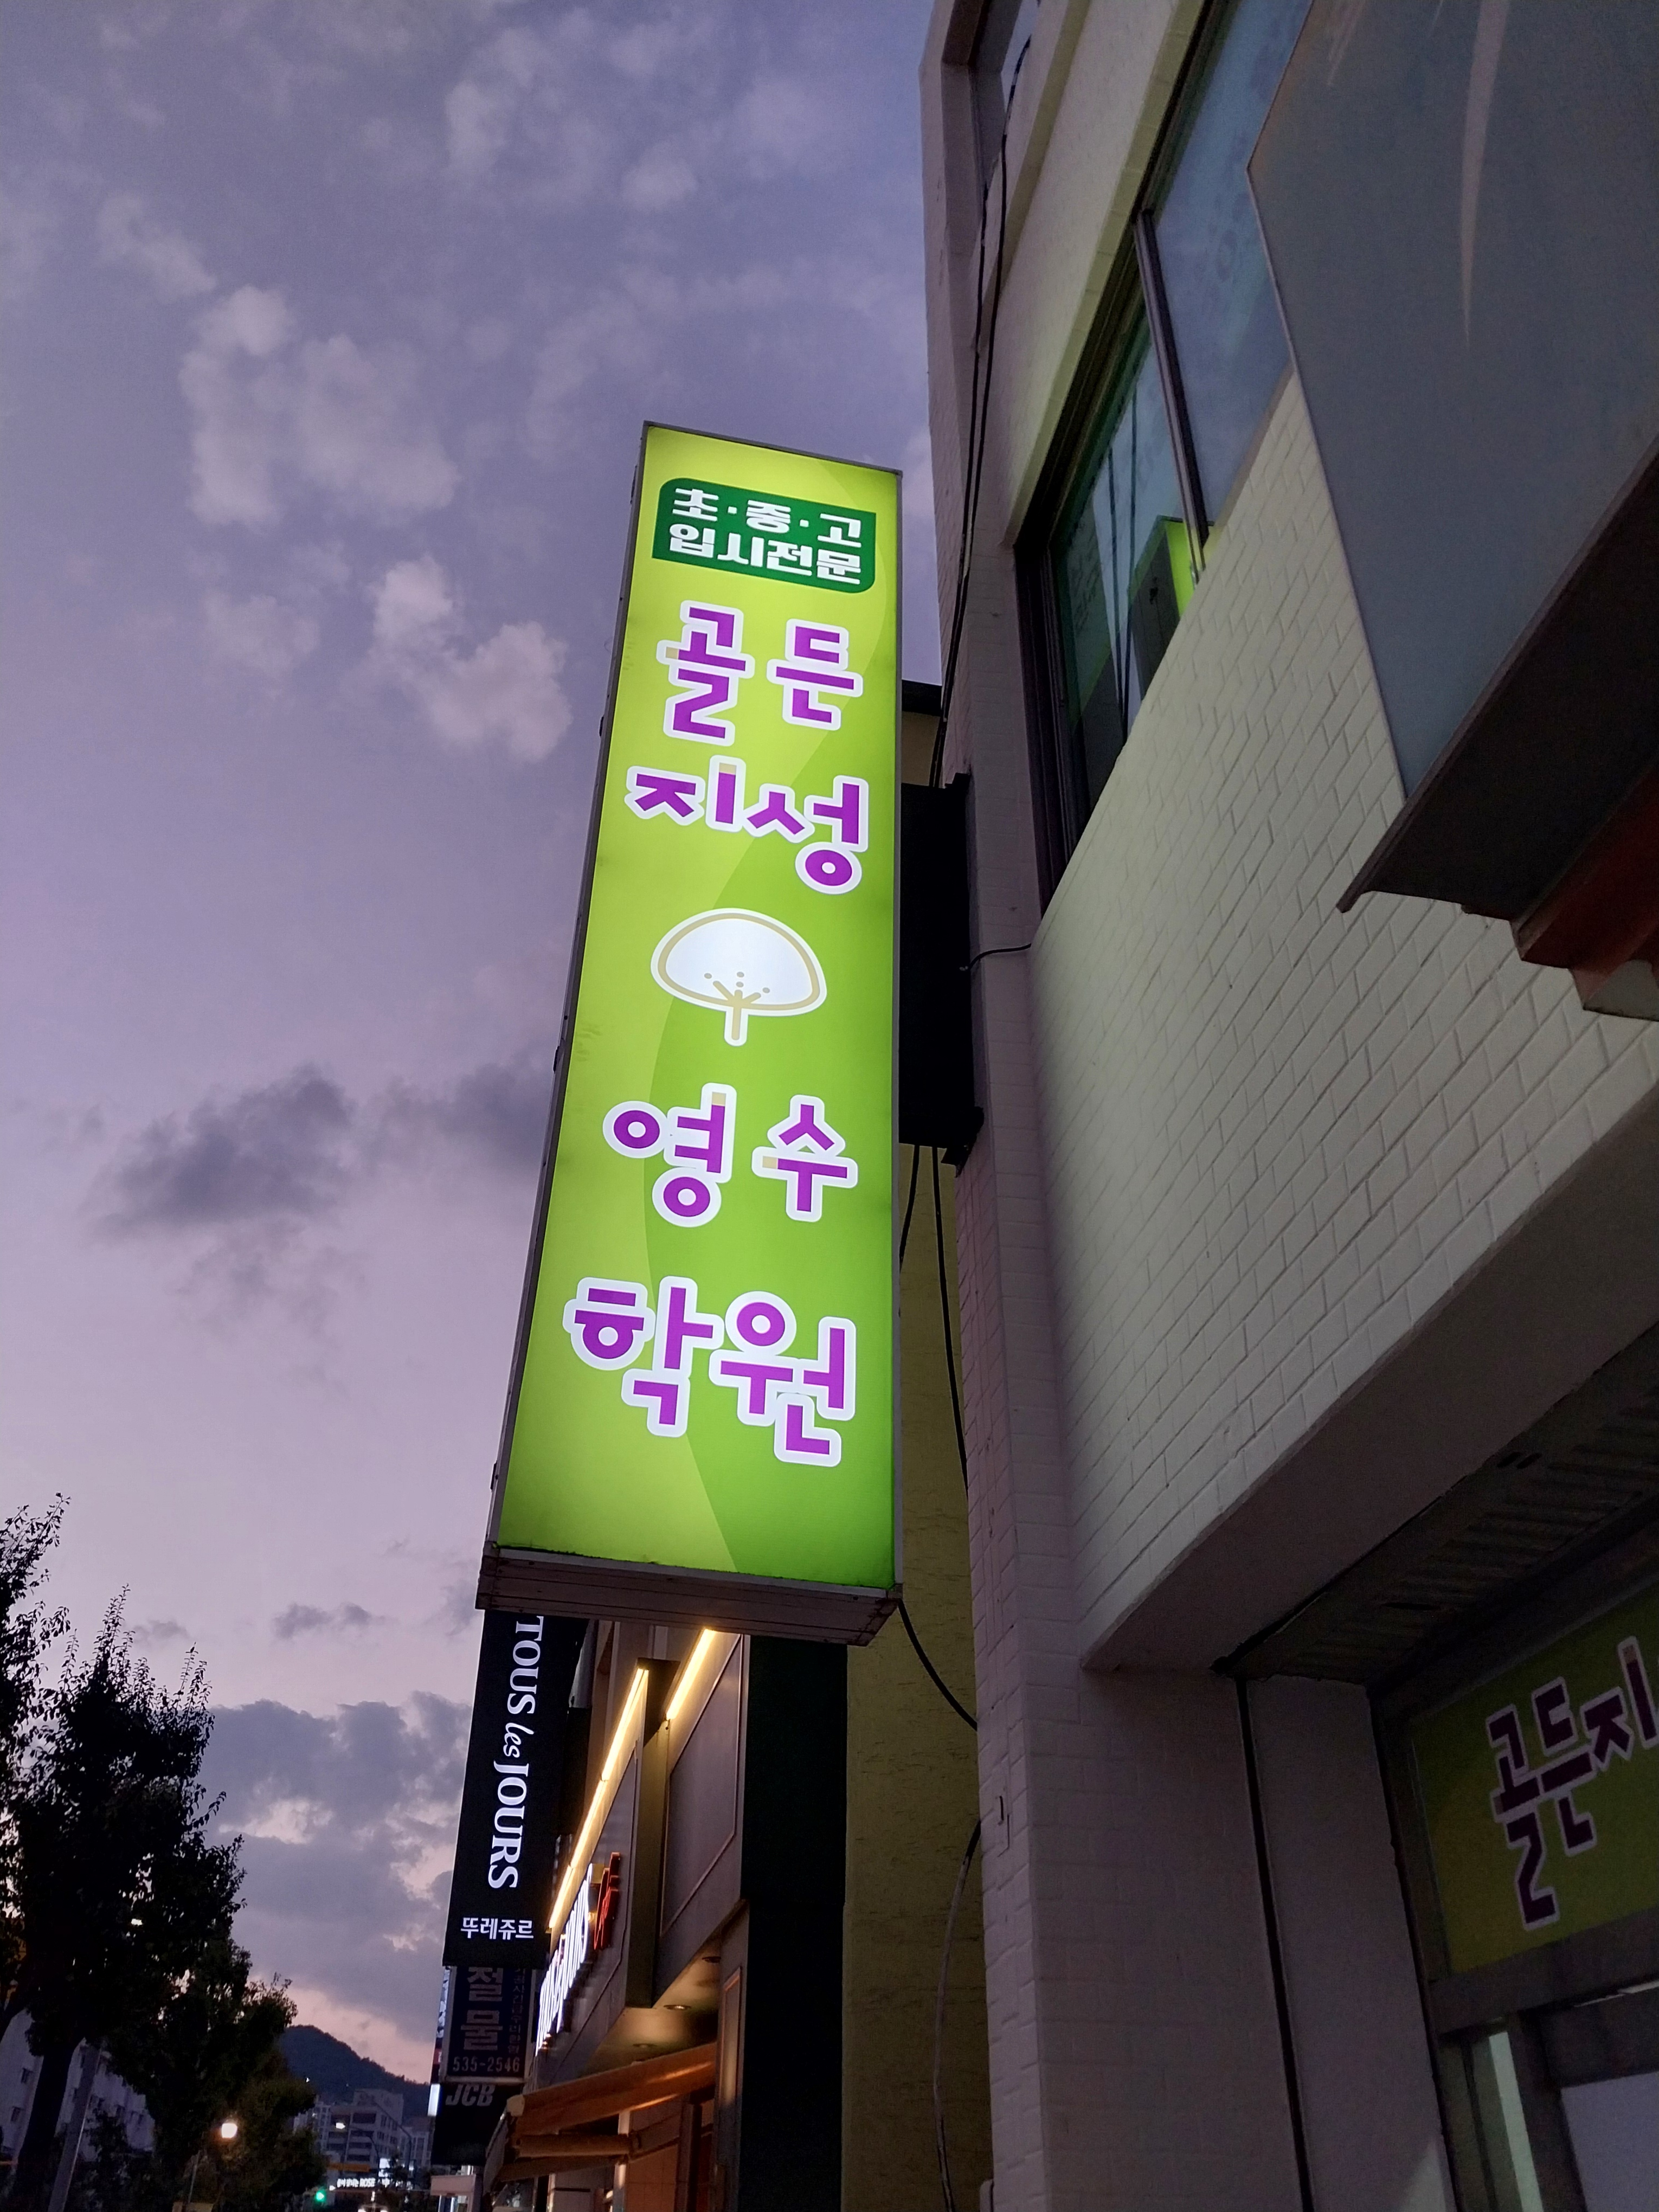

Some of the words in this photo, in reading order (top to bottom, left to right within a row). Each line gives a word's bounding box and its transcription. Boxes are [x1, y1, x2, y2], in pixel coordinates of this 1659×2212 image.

[669, 523, 861, 585] 입시전문
[627, 758, 865, 891] 지성
[568, 1281, 850, 1461] 학원
[507, 1615, 544, 1715] TOUS
[503, 1722, 535, 1758] les
[488, 1760, 529, 1889] JOURS
[460, 1917, 534, 1940] 뚜레쥬르
[452, 2055, 520, 2073] 535-2546
[445, 2084, 496, 2107] JCB
